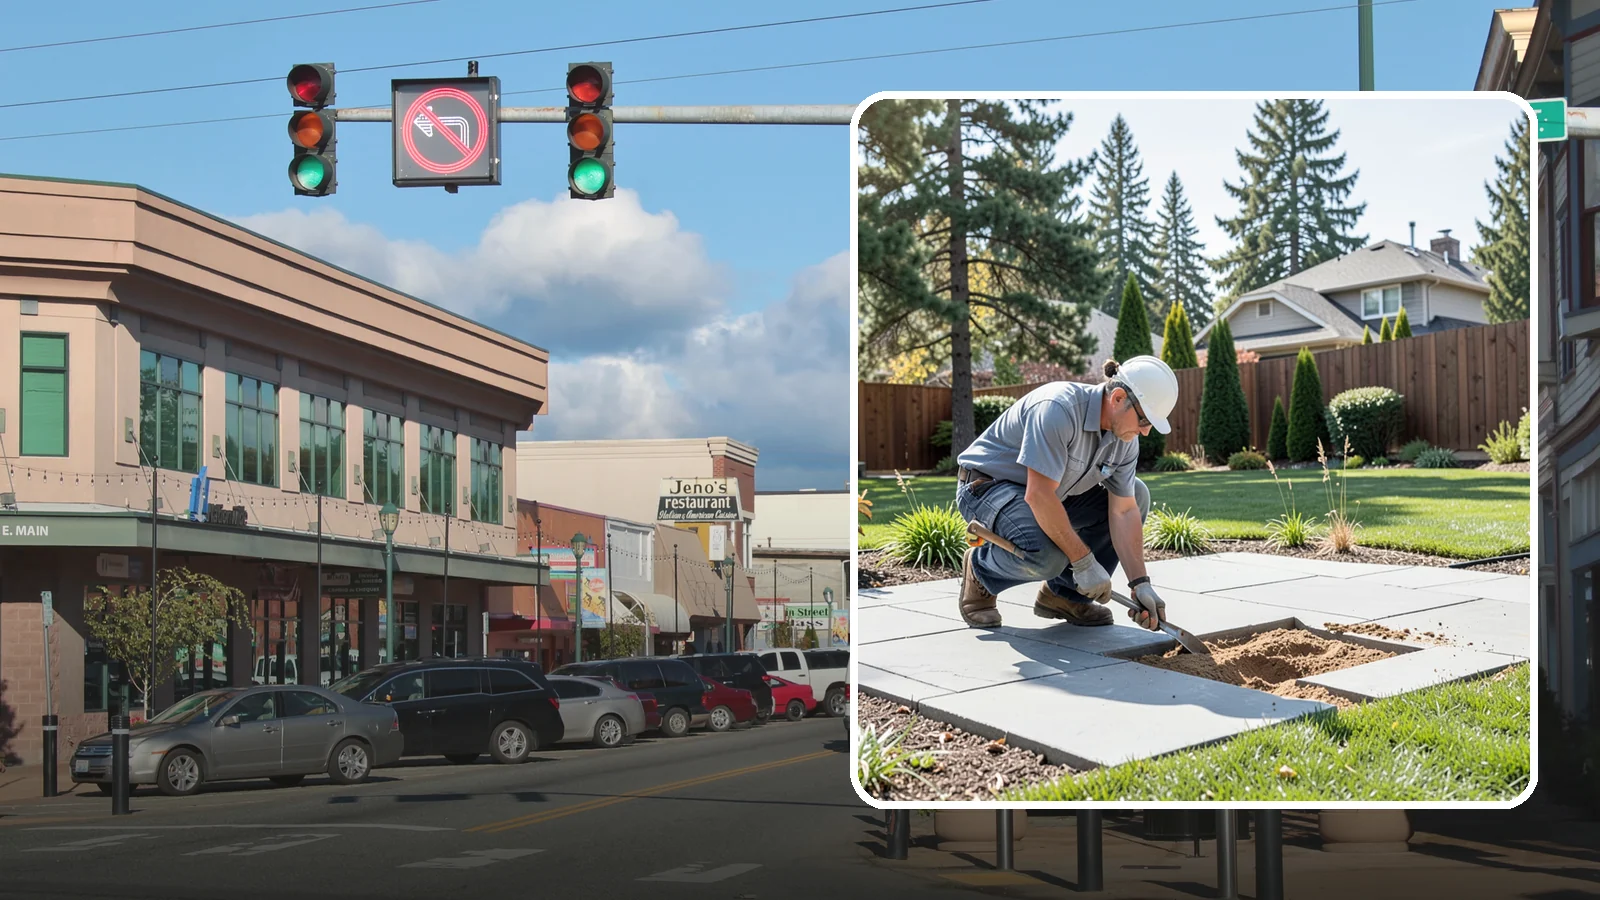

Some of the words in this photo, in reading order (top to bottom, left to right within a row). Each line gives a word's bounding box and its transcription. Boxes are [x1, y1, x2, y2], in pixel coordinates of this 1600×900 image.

[670, 480, 728, 494] Jeno's
[665, 496, 730, 508] restaurant
[659, 510, 682, 520] Italian
[686, 510, 715, 520] American
[715, 510, 737, 520] Cuisine
[2, 525, 13, 536] E.
[15, 525, 49, 536] MAIN
[798, 607, 828, 616] Street
